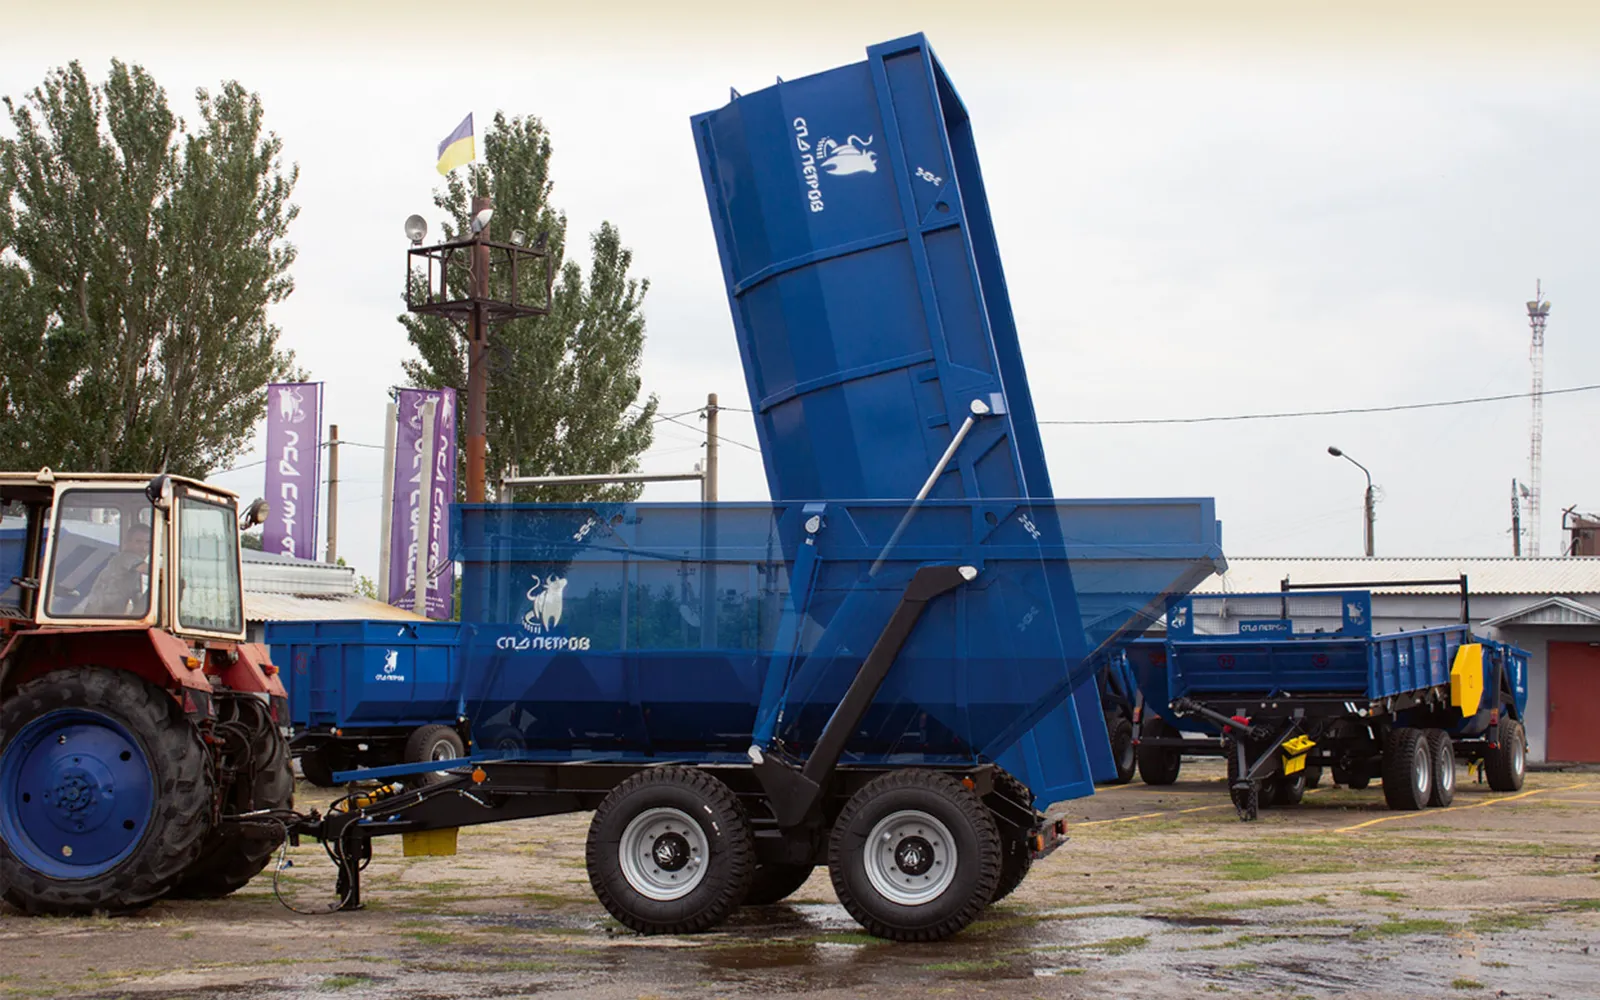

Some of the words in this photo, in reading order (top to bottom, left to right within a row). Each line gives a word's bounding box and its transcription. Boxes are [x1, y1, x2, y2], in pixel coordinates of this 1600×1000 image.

[793, 117, 811, 151] СПД
[802, 153, 824, 212] ПЕТРОВ
[496, 637, 530, 650] СПД
[532, 637, 591, 651] ПЕТРОВ
